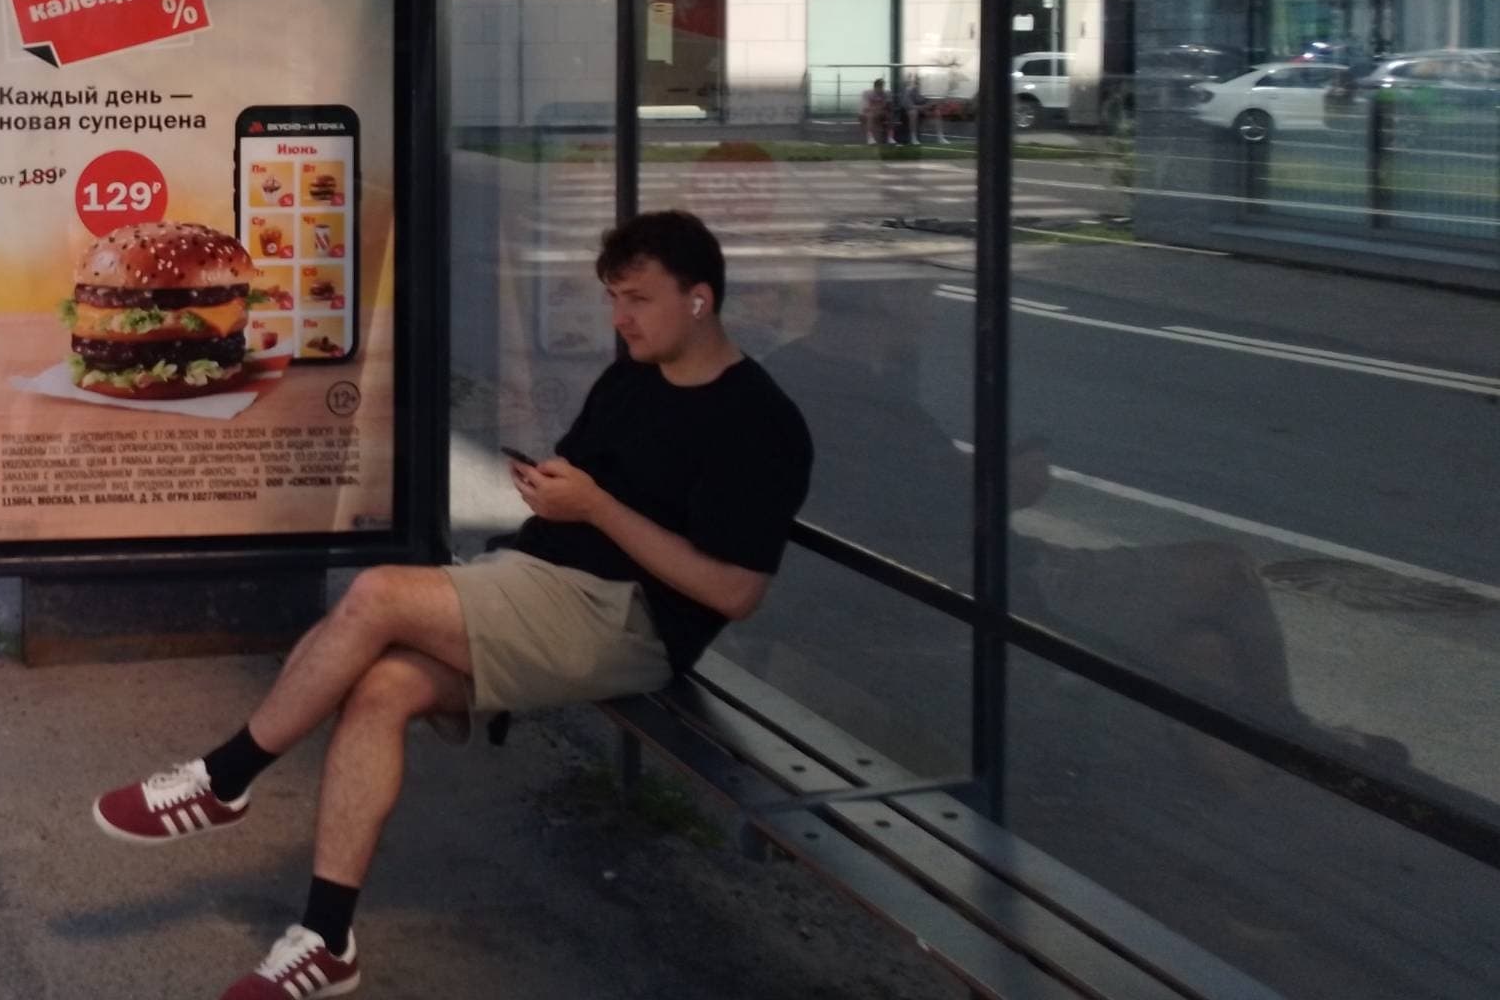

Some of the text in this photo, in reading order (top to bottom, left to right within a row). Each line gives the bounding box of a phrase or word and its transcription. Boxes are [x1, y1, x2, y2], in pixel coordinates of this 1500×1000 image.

[0, 85, 99, 108] Каждый
[104, 89, 163, 108] день
[0, 113, 207, 134] новая суперцена
[276, 143, 318, 155] Июнь
[0, 175, 15, 185] от
